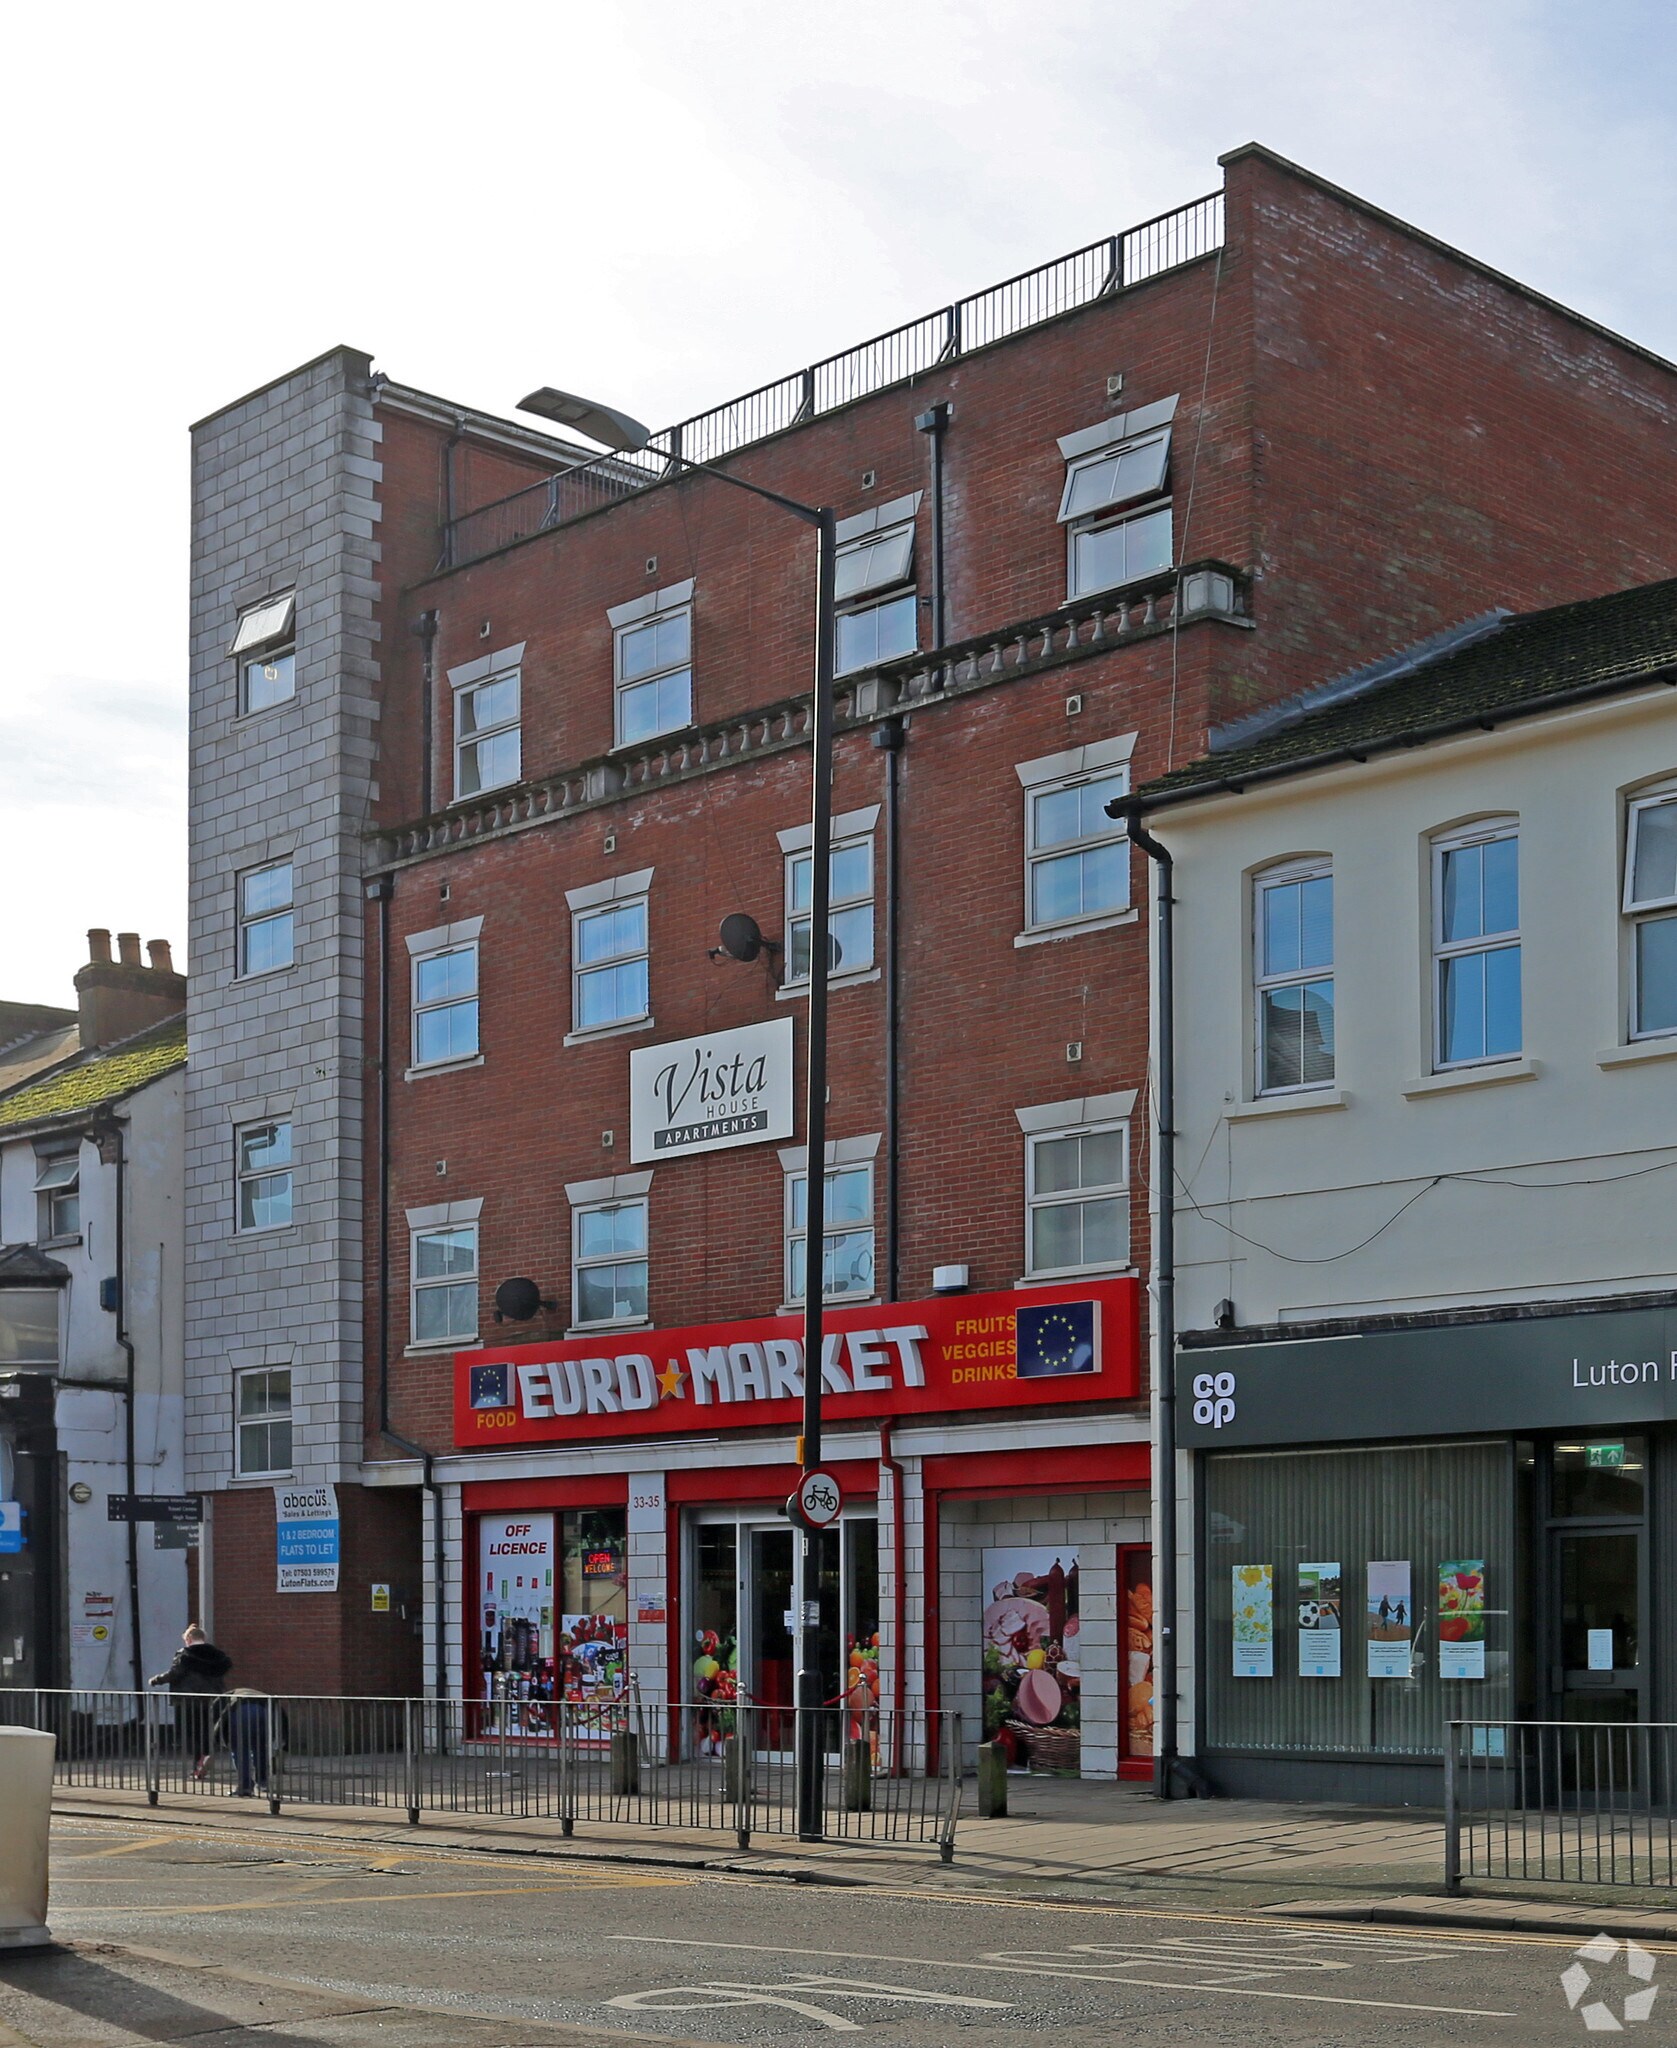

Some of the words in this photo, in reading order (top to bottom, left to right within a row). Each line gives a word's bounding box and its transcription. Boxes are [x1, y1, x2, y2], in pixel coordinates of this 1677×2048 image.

[654, 1048, 768, 1125] Vista
[706, 1096, 758, 1119] HOUSE
[665, 1116, 758, 1145] APARTMENTS
[956, 1315, 1016, 1336] FRUITS
[941, 1339, 1016, 1361] VEGGIES
[517, 1354, 659, 1419] EURO
[686, 1325, 929, 1405] MARKET
[952, 1363, 1016, 1384] DRINKS
[1573, 1358, 1658, 1387] Luton
[477, 1412, 516, 1429] FOOD
[634, 1495, 659, 1508] 33-35
[297, 1529, 335, 1540] BEDROOM
[505, 1524, 531, 1537] OFF
[281, 1545, 304, 1556] FLATS
[305, 1544, 317, 1555] TO
[318, 1543, 334, 1555] LET
[489, 1542, 547, 1555] LICENCE
[588, 1553, 611, 1564] OPEN
